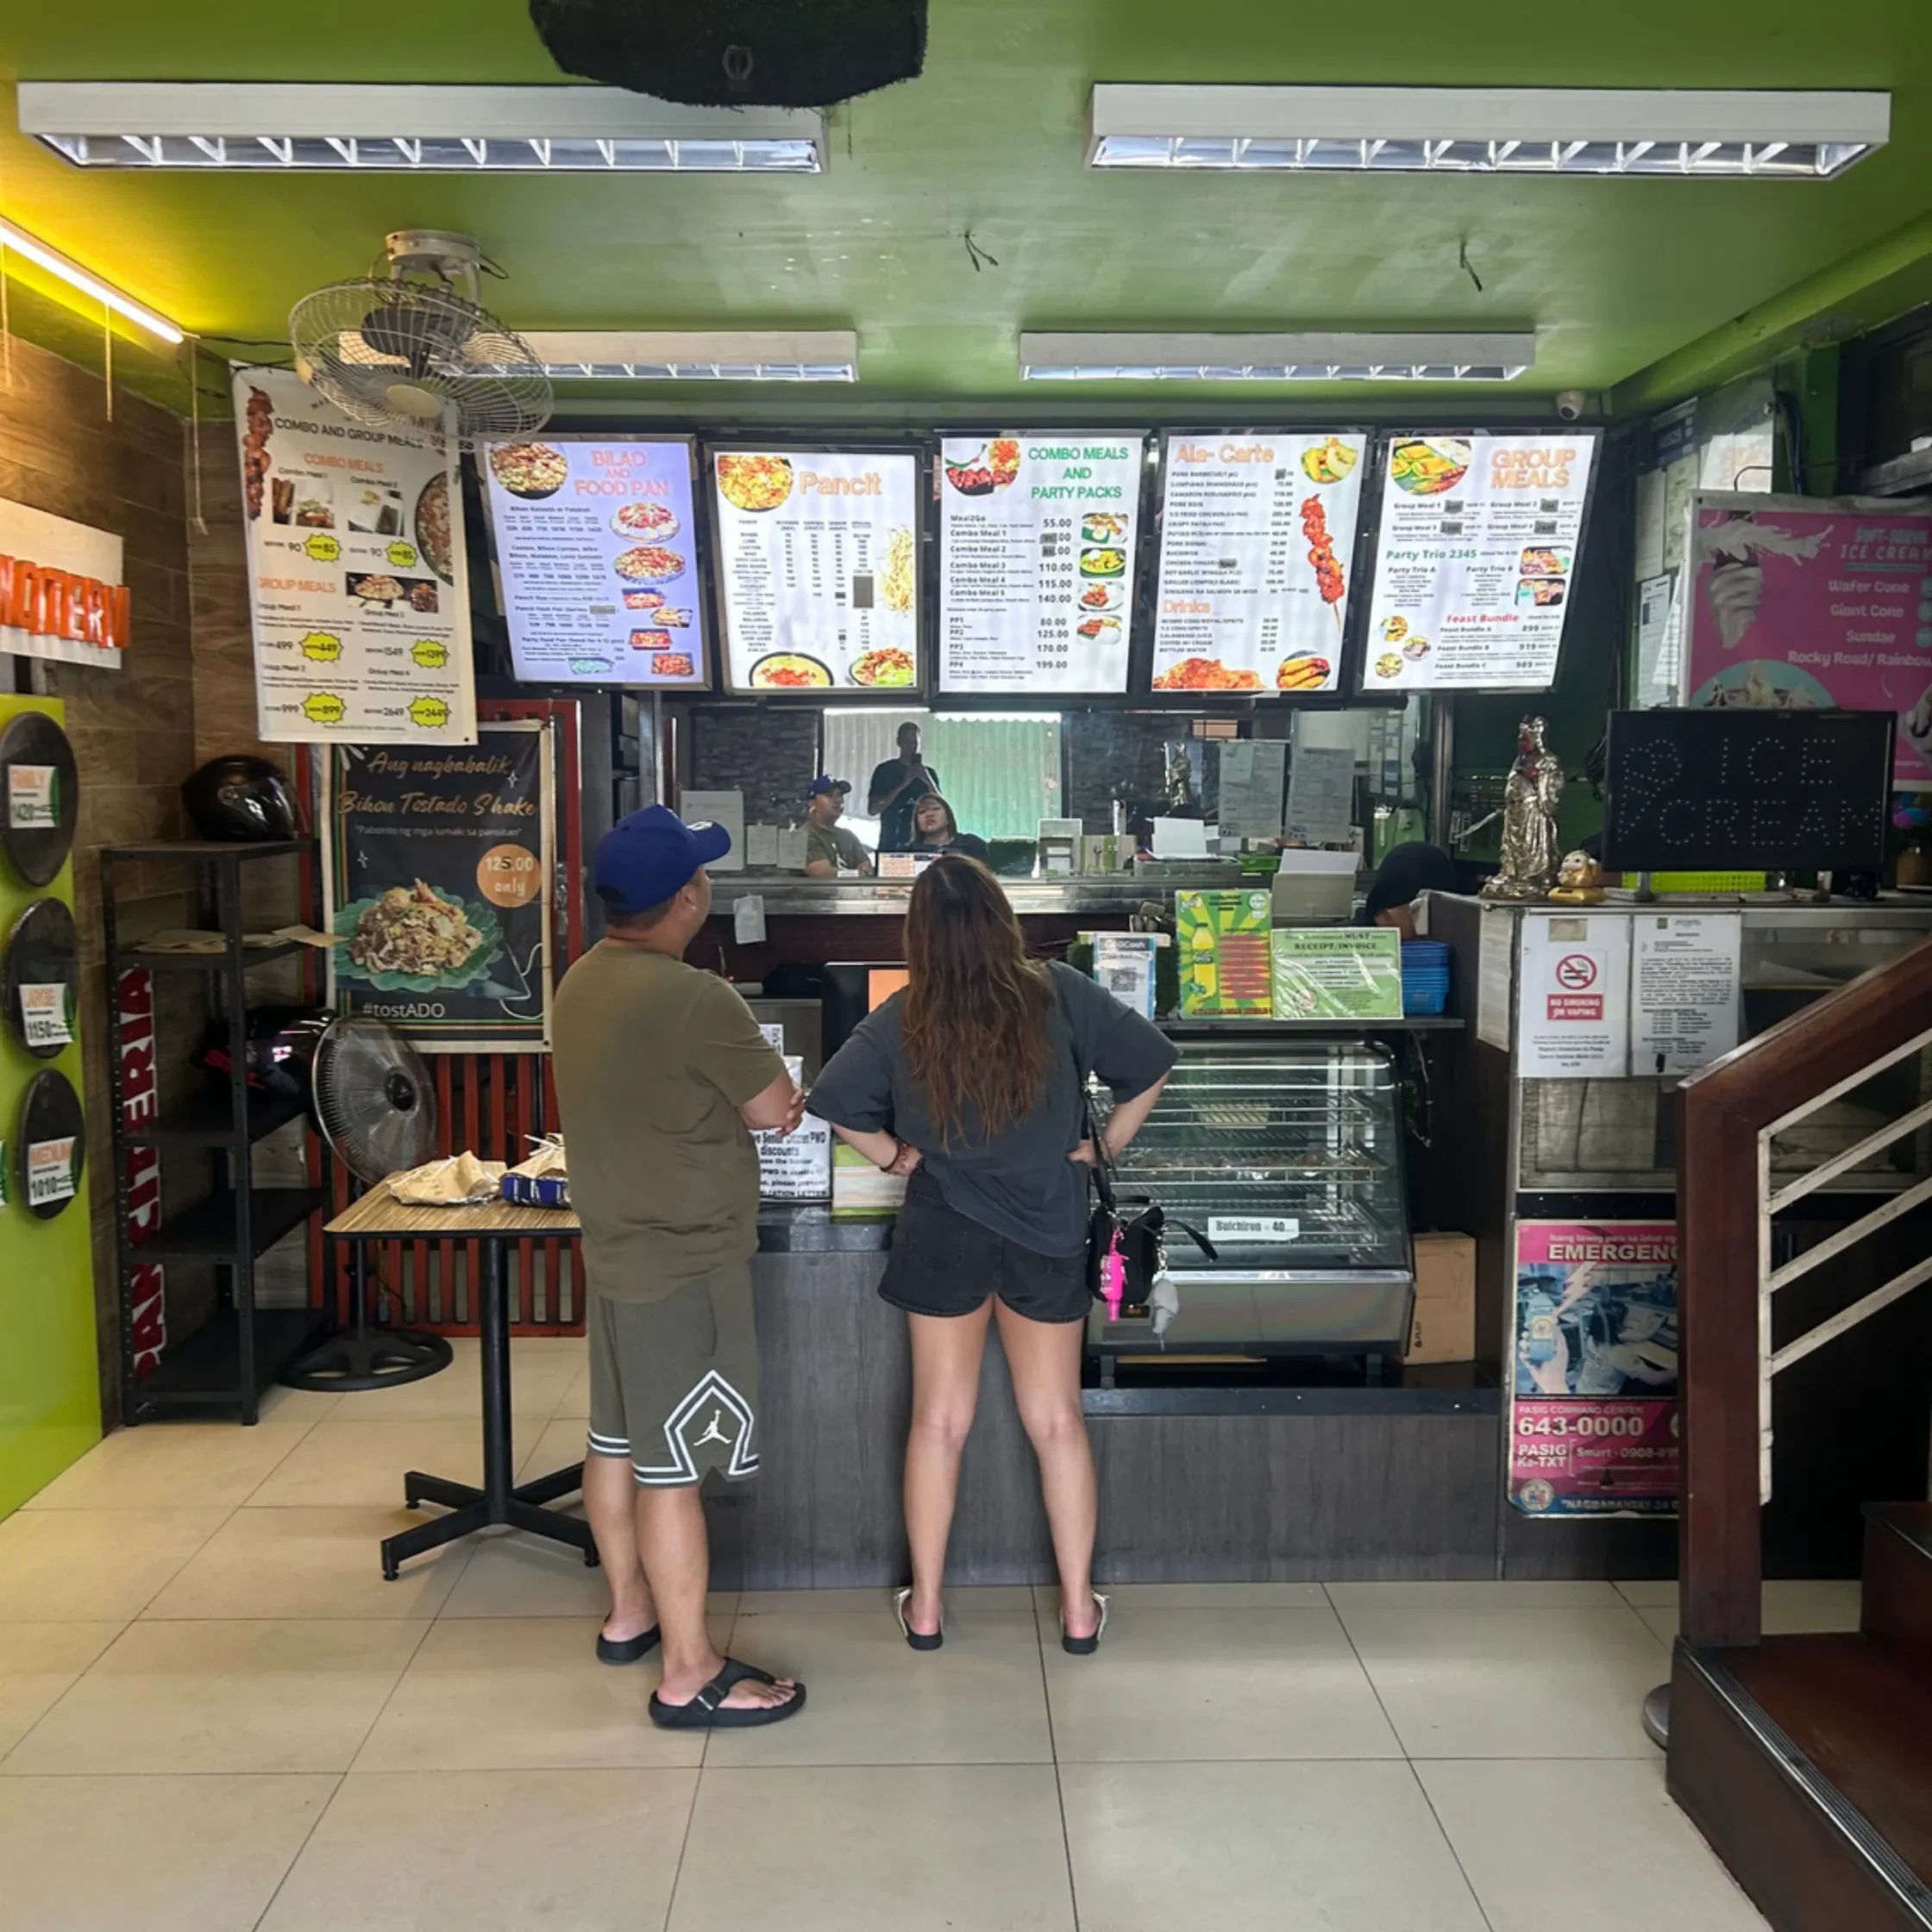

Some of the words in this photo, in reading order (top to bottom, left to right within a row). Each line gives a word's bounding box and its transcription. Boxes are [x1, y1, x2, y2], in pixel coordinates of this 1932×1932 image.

[274, 417, 319, 434] COMBO
[321, 424, 345, 438] AND
[347, 428, 386, 443] GROUP
[592, 450, 647, 469] BILAO
[1028, 447, 1081, 461] COMBO
[1083, 447, 1128, 461] MEALS
[1219, 444, 1275, 463] Carte
[1490, 448, 1577, 468] GROUP
[304, 453, 345, 469] COMBO
[348, 458, 385, 474] MEALS
[605, 468, 630, 479] AND
[1063, 467, 1092, 480] AND
[1490, 469, 1571, 489] MEALS
[574, 480, 629, 497] FOOD
[630, 480, 670, 497] PAN
[799, 472, 882, 496] Pancit
[1031, 487, 1076, 499] PARTY
[1077, 486, 1123, 499] PACKS
[1043, 518, 1073, 528] 55.00
[288, 543, 302, 553] 90
[323, 543, 336, 554] 85
[371, 548, 383, 557] 90
[950, 545, 978, 554] Combo
[980, 545, 1000, 554] Meal
[1386, 550, 1420, 561] Party
[1423, 549, 1446, 560] Trio
[1449, 549, 1477, 559] 2345
[1840, 544, 1869, 560] ICE
[950, 561, 978, 569] Combo
[980, 561, 1000, 569] Meal
[1038, 562, 1073, 573] 110.00
[1466, 566, 1489, 574] Party
[1038, 579, 1073, 589] 115.00
[1828, 580, 1872, 593] Wafer
[1874, 581, 1910, 593] Cone
[1038, 594, 1072, 604] 140.00
[1162, 599, 1211, 614] Drinks
[1830, 602, 1867, 618] Giant
[1870, 605, 1904, 618] Cone
[1040, 618, 1067, 626] 80.00
[1446, 614, 1477, 624] Feast
[1478, 613, 1520, 623] Bundle
[1037, 630, 1069, 639] 125.00
[1846, 630, 1897, 643] Sundae
[1036, 661, 1068, 669] 199.00
[1788, 650, 1831, 668] Rocky
[367, 751, 410, 780] Ang
[411, 755, 512, 780] nagbabalik
[1720, 737, 1836, 784] ICE
[336, 790, 396, 815] Bihon
[399, 792, 468, 815] Tostado
[1659, 798, 1882, 846] CREAM
[399, 826, 411, 837] ng
[486, 856, 534, 872] 125.00
[494, 880, 527, 898] only
[1117, 939, 1145, 948] GCash
[1563, 998, 1601, 1007] SMOKING
[361, 1002, 445, 1019] #tostADO
[1553, 1008, 1565, 1018] OR
[1567, 1007, 1596, 1017] VAPING
[1272, 1220, 1286, 1232] 40
[1550, 1406, 1601, 1414] COMMAND
[1603, 1406, 1644, 1414] CENTER
[1518, 1416, 1644, 1436] 643-0000
[1518, 1444, 1567, 1456] PASIG
[1577, 1446, 1612, 1458] Smart
[1517, 1456, 1567, 1467] Ka-TXT
